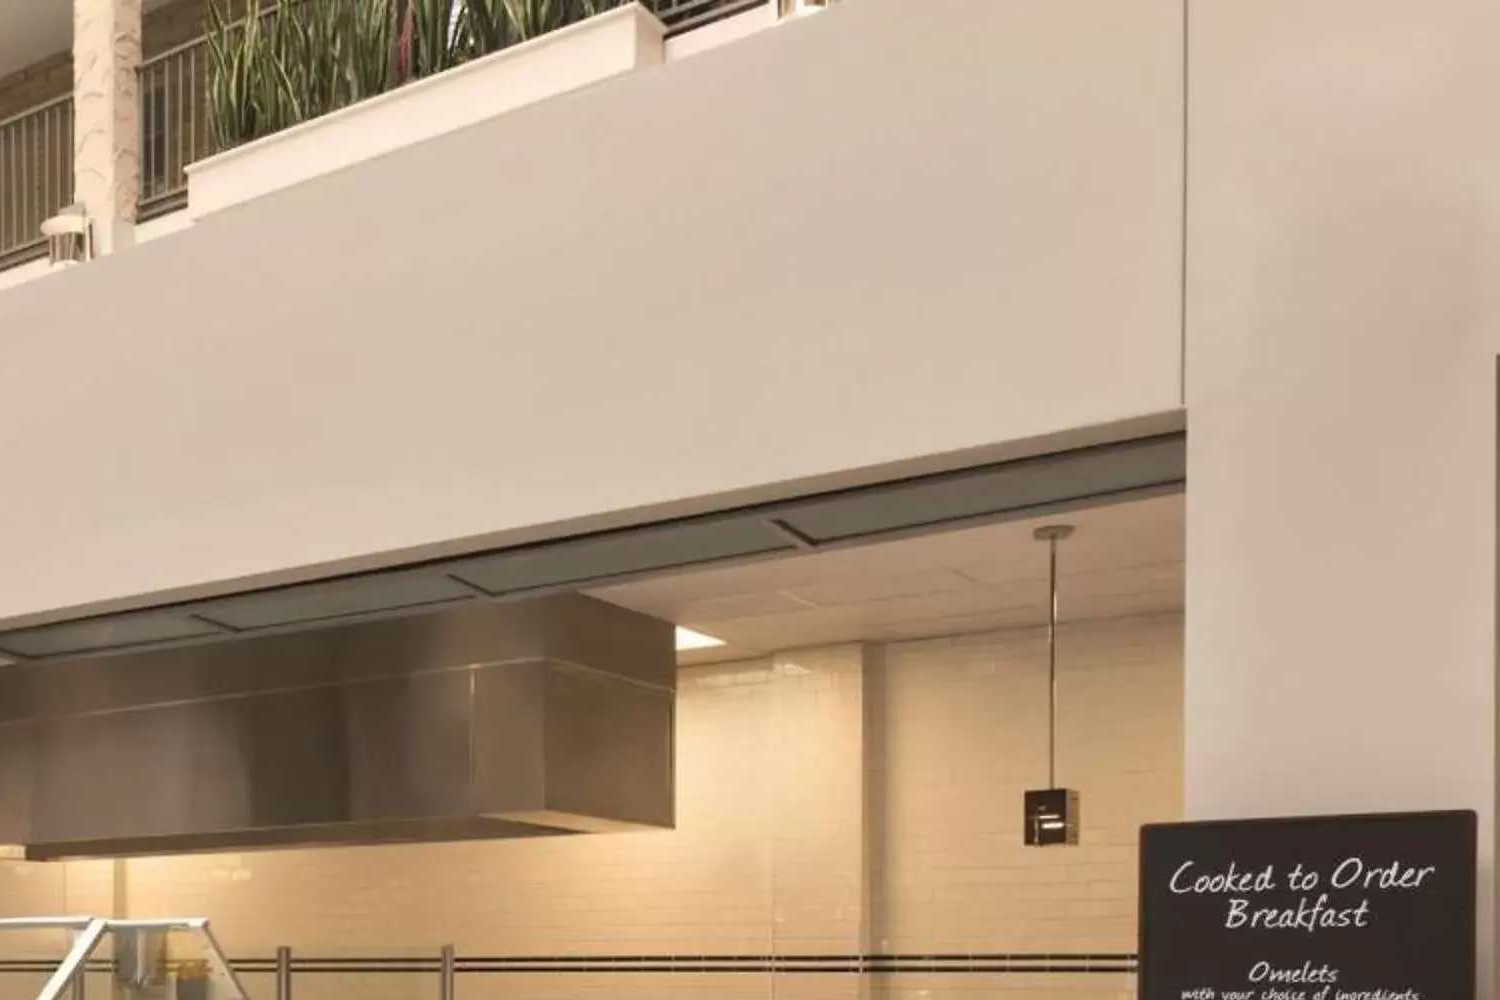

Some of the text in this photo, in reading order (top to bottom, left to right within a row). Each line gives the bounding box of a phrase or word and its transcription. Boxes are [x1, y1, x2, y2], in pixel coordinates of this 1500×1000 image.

[1168, 857, 1435, 894] Cooked to Order
[1224, 893, 1370, 932] Breakfast
[1248, 960, 1339, 983] Omelets
[1181, 987, 1216, 1000] with
[1261, 987, 1306, 1000] choice
